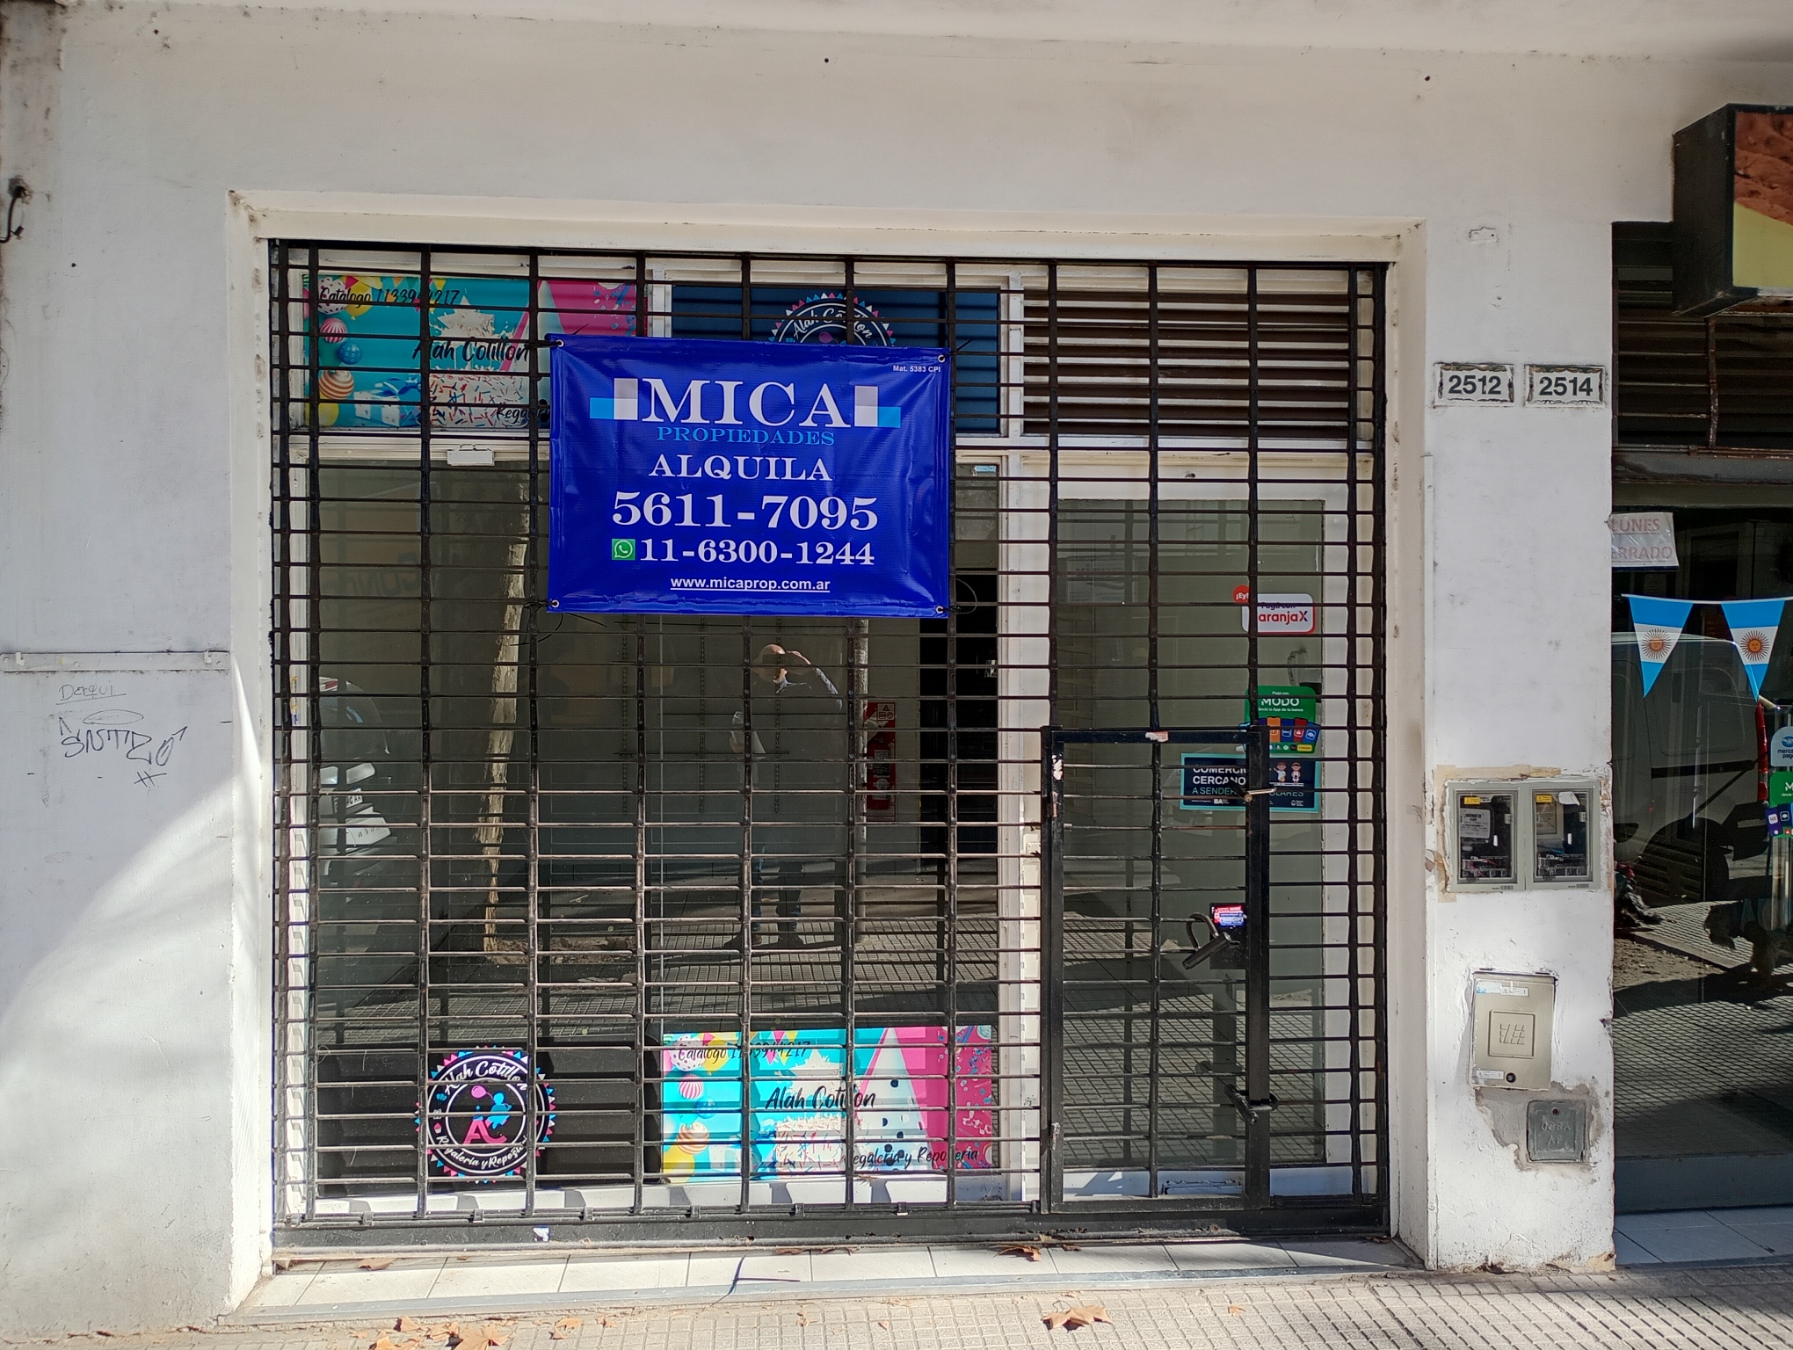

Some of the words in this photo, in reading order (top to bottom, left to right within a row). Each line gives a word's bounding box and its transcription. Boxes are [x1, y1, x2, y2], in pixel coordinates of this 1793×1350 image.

[320, 286, 371, 308] Catalogo
[376, 288, 460, 305] 113394217
[892, 364, 908, 372] Mat.
[1448, 374, 1502, 395] 2512
[1538, 376, 1593, 396] 2514
[641, 377, 852, 428] MICA
[656, 426, 836, 446] PROPIEDADES
[648, 454, 833, 482] ALQUILA
[611, 490, 878, 531] 5611-7095
[1611, 518, 1660, 532] LUNES
[639, 538, 876, 566] 11-6300-1244
[1611, 546, 1674, 559] ERRADO
[670, 576, 831, 593] www.micaprop.com.ar
[1257, 611, 1308, 625] aranjaX
[1261, 697, 1300, 707] MODO
[1192, 775, 1247, 786] CERCANO
[765, 1086, 805, 1110] Alah
[812, 1085, 876, 1110] Cotion
[847, 1146, 901, 1170] egaleria
[902, 1152, 912, 1170] y
